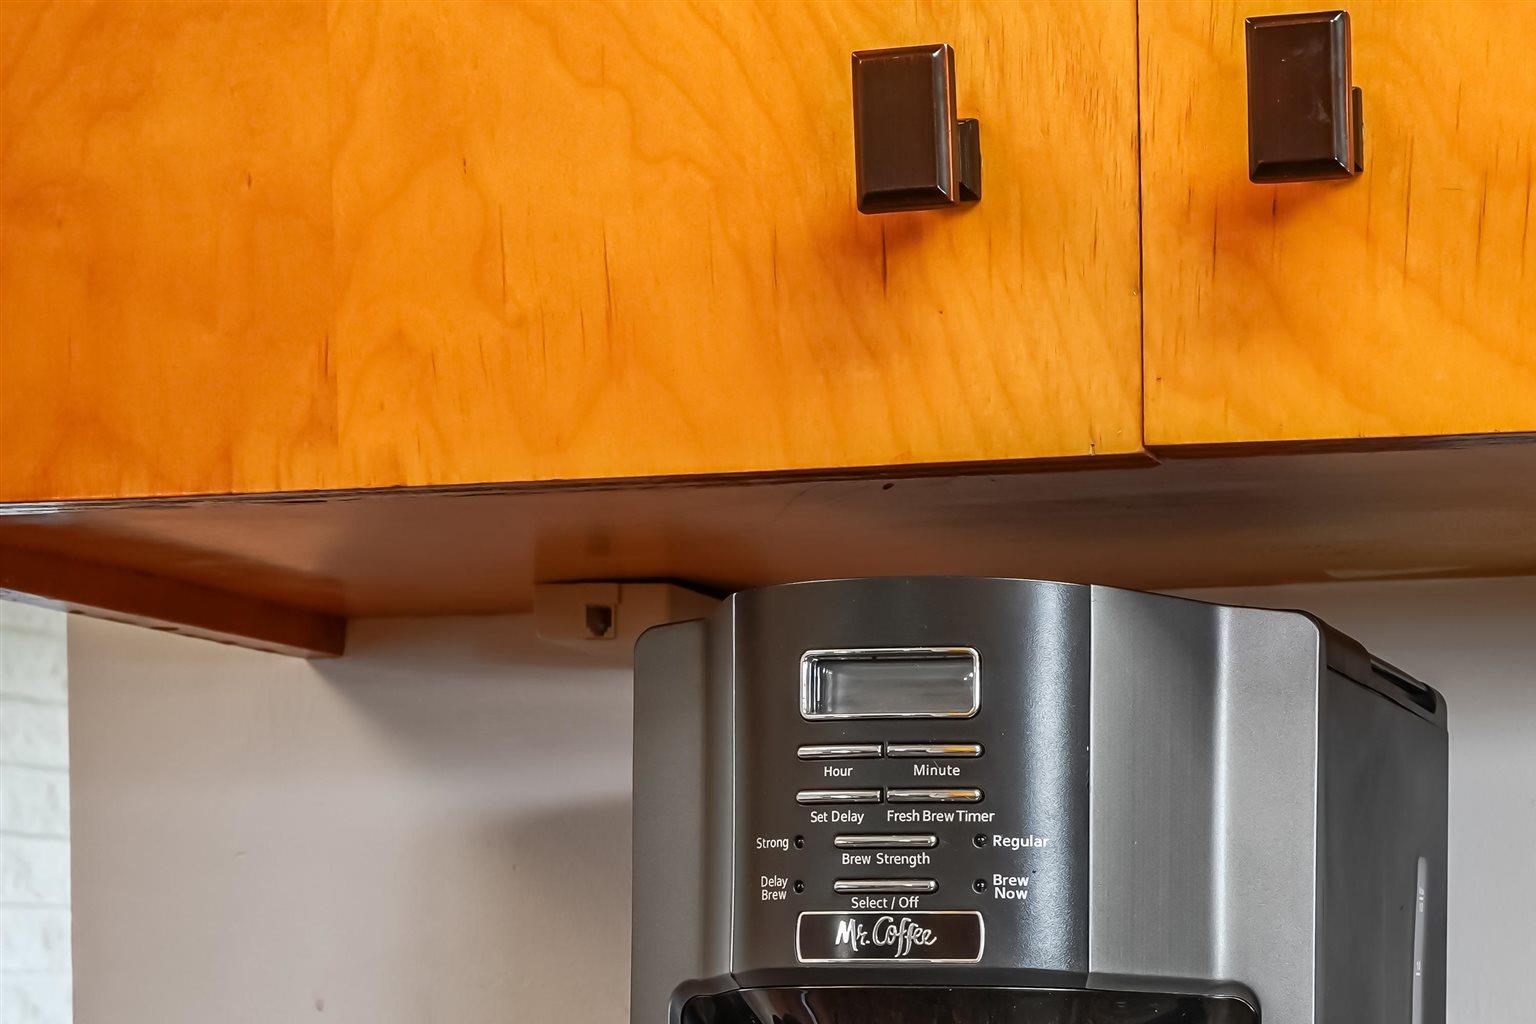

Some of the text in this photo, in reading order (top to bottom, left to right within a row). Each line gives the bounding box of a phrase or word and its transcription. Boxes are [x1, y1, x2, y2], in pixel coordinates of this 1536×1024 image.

[823, 765, 853, 777] Hour
[912, 764, 960, 776] Minute
[810, 810, 865, 824] Set Delay
[887, 809, 995, 823] Fresh Brew Timer
[756, 837, 789, 851] Strong
[992, 834, 1050, 850] Regular
[841, 852, 930, 867] Brew Strength
[760, 875, 788, 888] Delay
[992, 873, 1029, 887] Brew
[761, 889, 787, 900] Brew
[994, 886, 1028, 900] Now
[851, 896, 919, 910] Select / Off
[835, 915, 938, 958] Mr. Coffee
